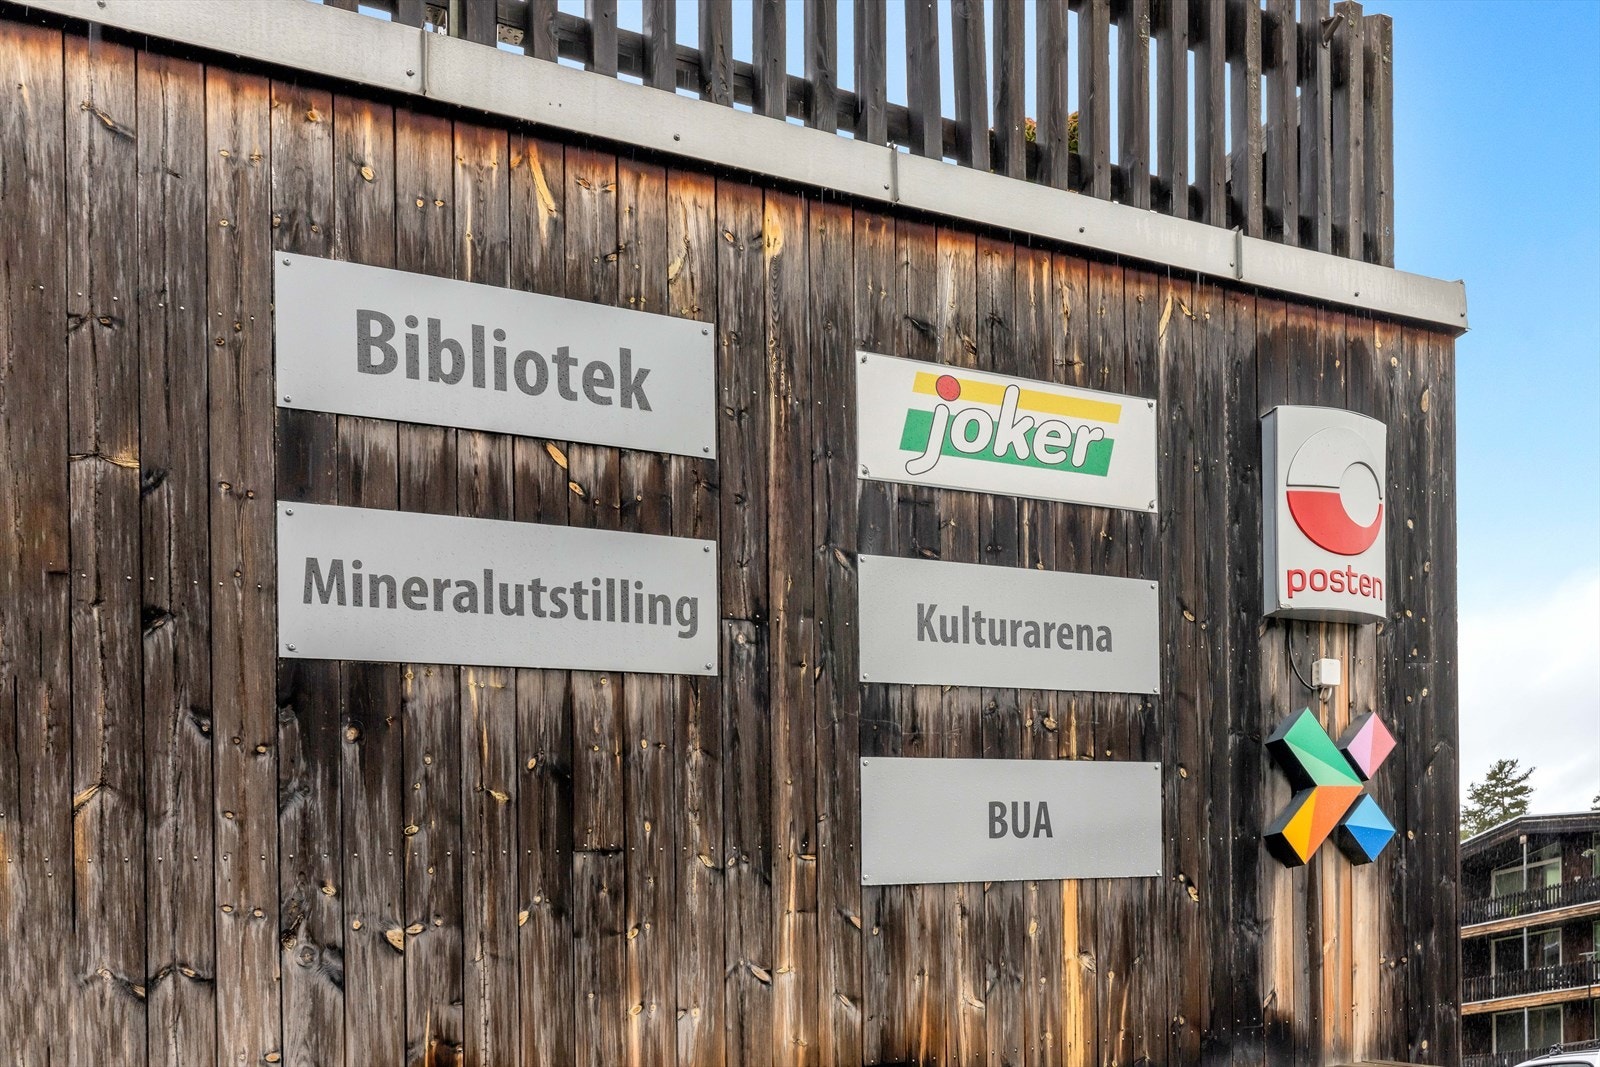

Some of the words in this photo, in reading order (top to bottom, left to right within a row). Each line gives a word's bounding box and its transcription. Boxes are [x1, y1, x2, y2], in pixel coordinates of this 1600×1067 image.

[356, 308, 653, 412] Bibliotek
[905, 374, 1105, 476] joker
[303, 557, 699, 639] Mineralutstilling
[1287, 564, 1383, 601] posten
[917, 602, 1113, 653] Kulturarena
[988, 801, 1054, 840] BUA
